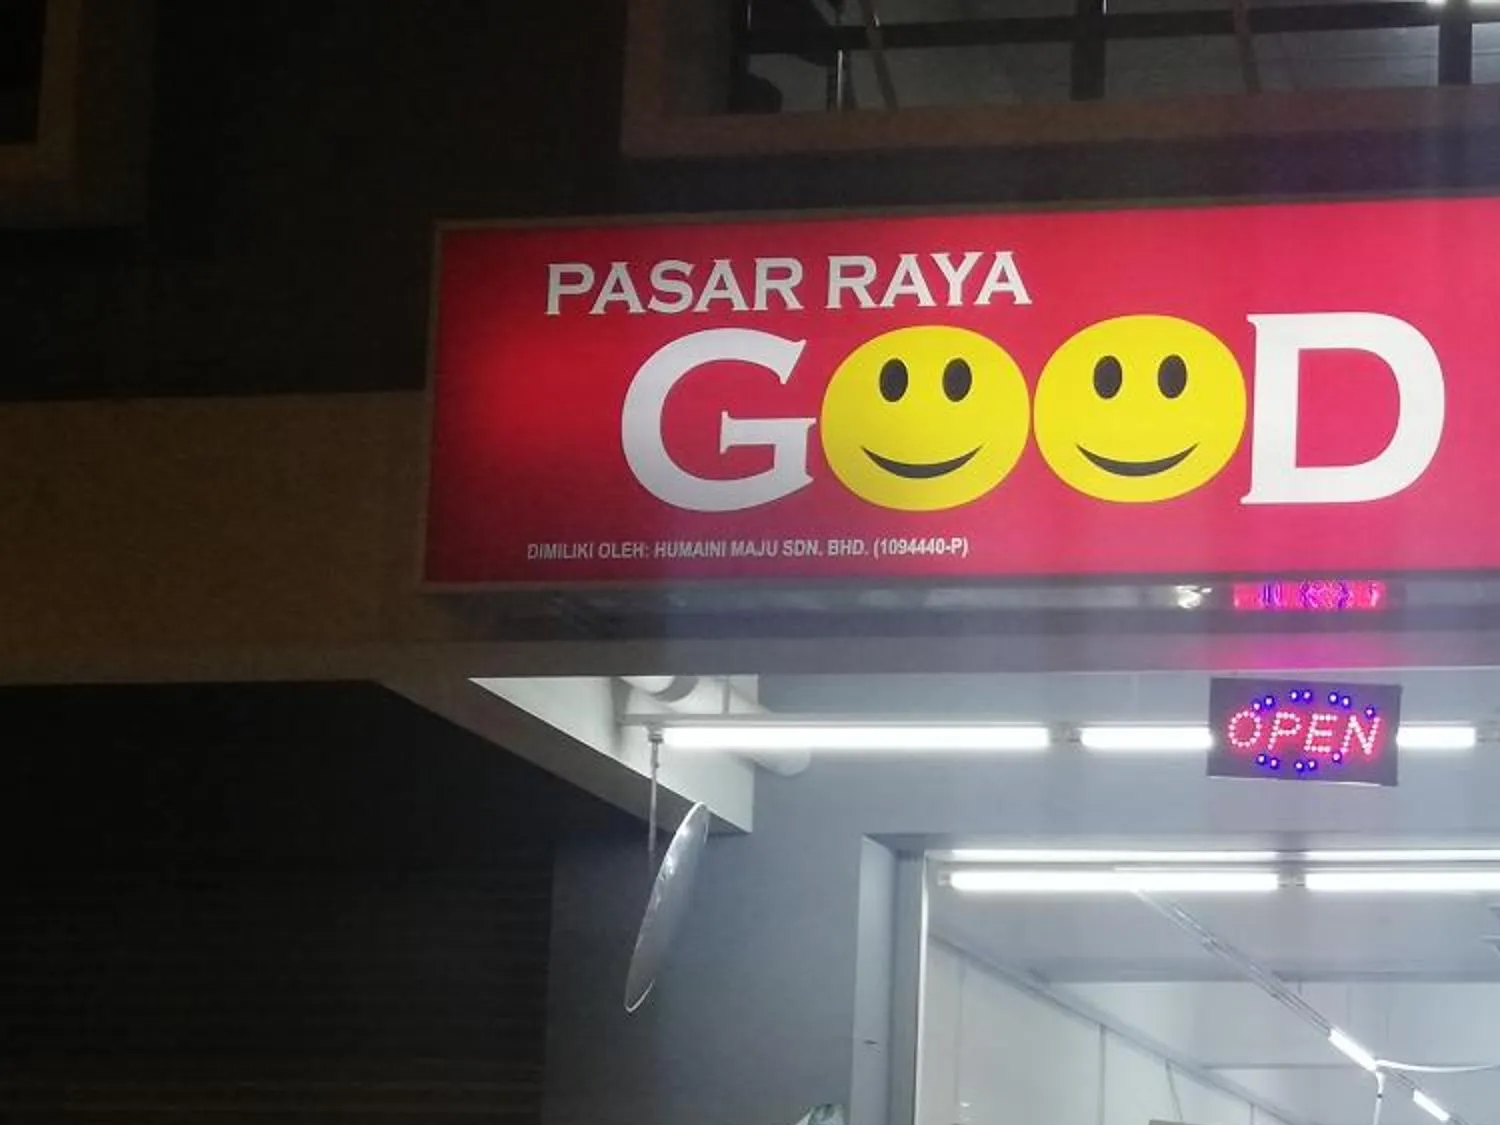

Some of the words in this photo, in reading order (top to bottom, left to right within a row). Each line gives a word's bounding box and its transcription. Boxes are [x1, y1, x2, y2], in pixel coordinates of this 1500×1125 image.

[544, 257, 806, 315] PASAR
[826, 251, 1031, 309] RAYA
[527, 543, 593, 560] DIMILIKI
[598, 542, 650, 559] OLEH:
[654, 541, 726, 558] HUMAINI
[730, 541, 777, 557] MAJU
[782, 539, 822, 557] SDN.
[828, 539, 868, 557] BHD.
[874, 537, 968, 559] (1094440-P)
[1228, 710, 1381, 755] OPEN
